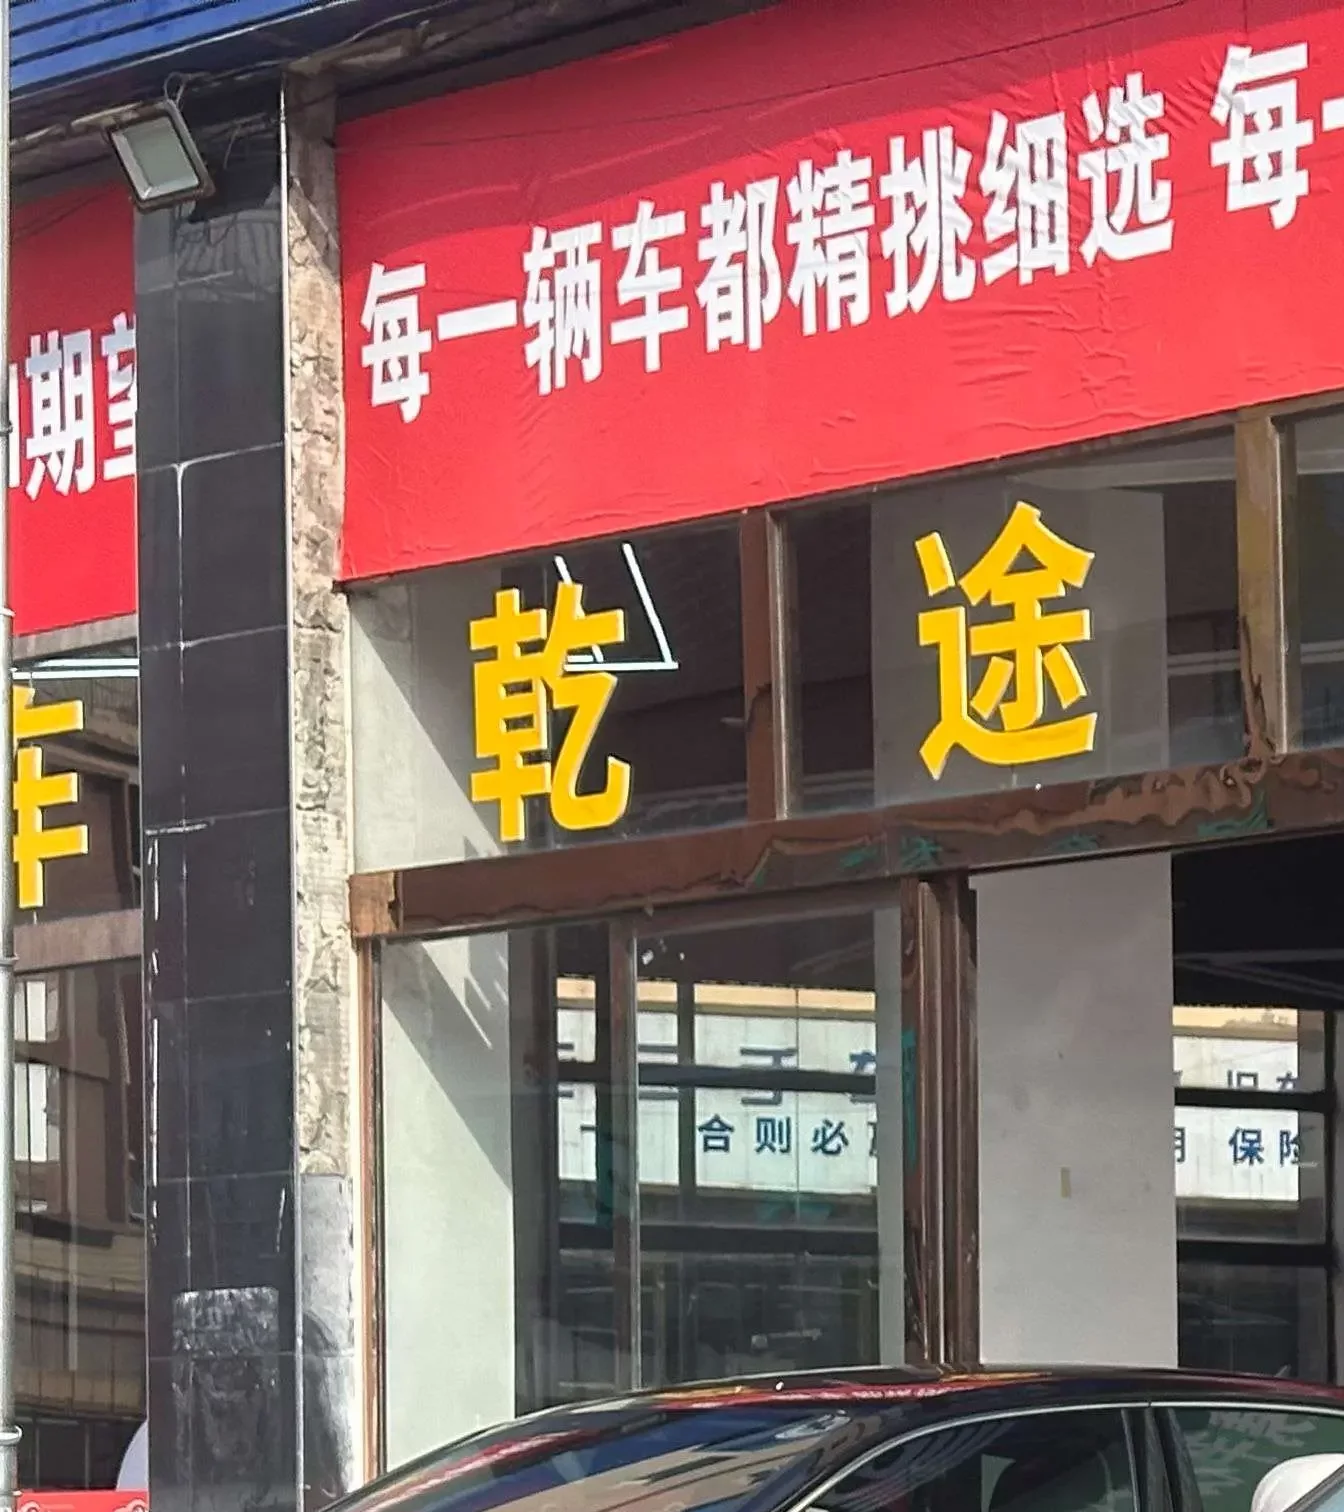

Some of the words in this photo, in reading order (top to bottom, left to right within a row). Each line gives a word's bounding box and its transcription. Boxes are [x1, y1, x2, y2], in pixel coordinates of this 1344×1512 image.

[360, 72, 1174, 424] 每一辆车都精挑细选
[698, 1113, 878, 1156] 合则必
